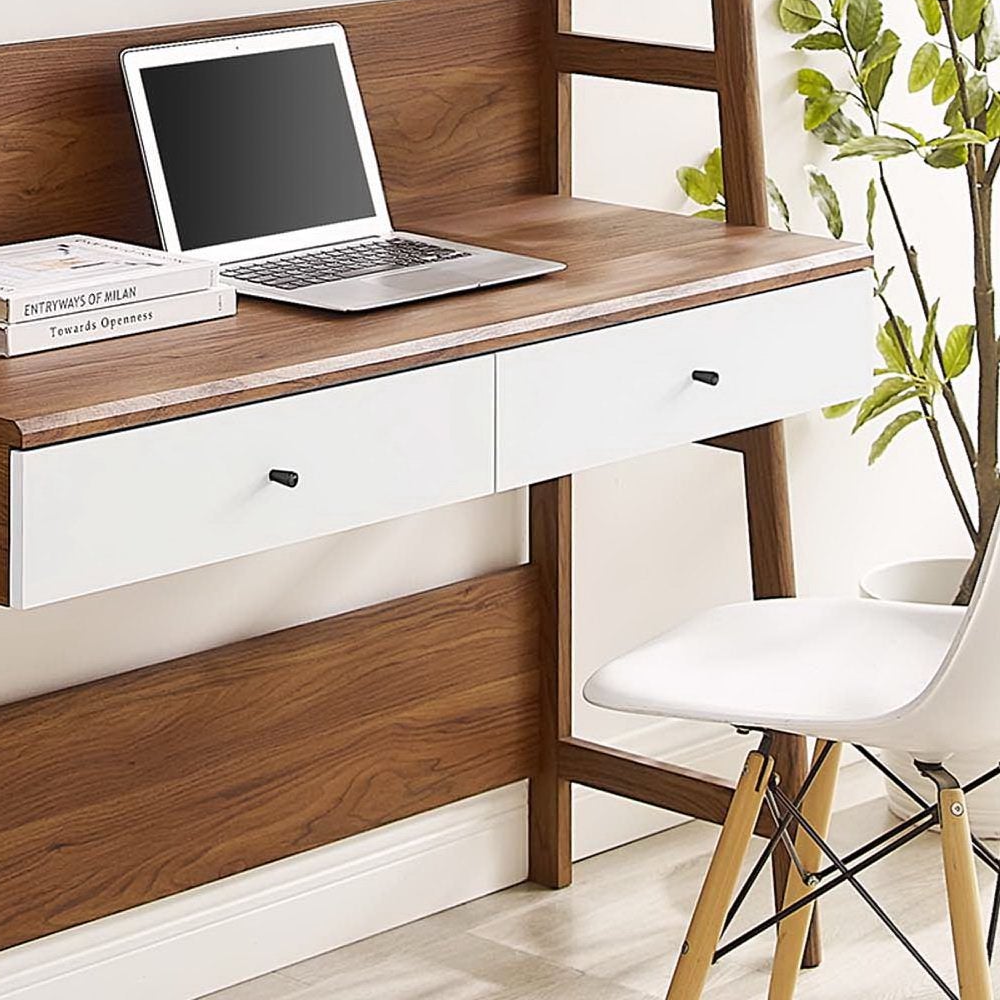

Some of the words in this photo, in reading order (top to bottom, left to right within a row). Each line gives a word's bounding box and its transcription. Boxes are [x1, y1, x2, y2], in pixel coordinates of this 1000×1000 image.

[23, 292, 86, 317] ENTRYWAYS
[87, 291, 103, 306] OF
[104, 286, 137, 303] MILAN
[49, 318, 97, 338] Towards
[100, 311, 154, 329] Openness
